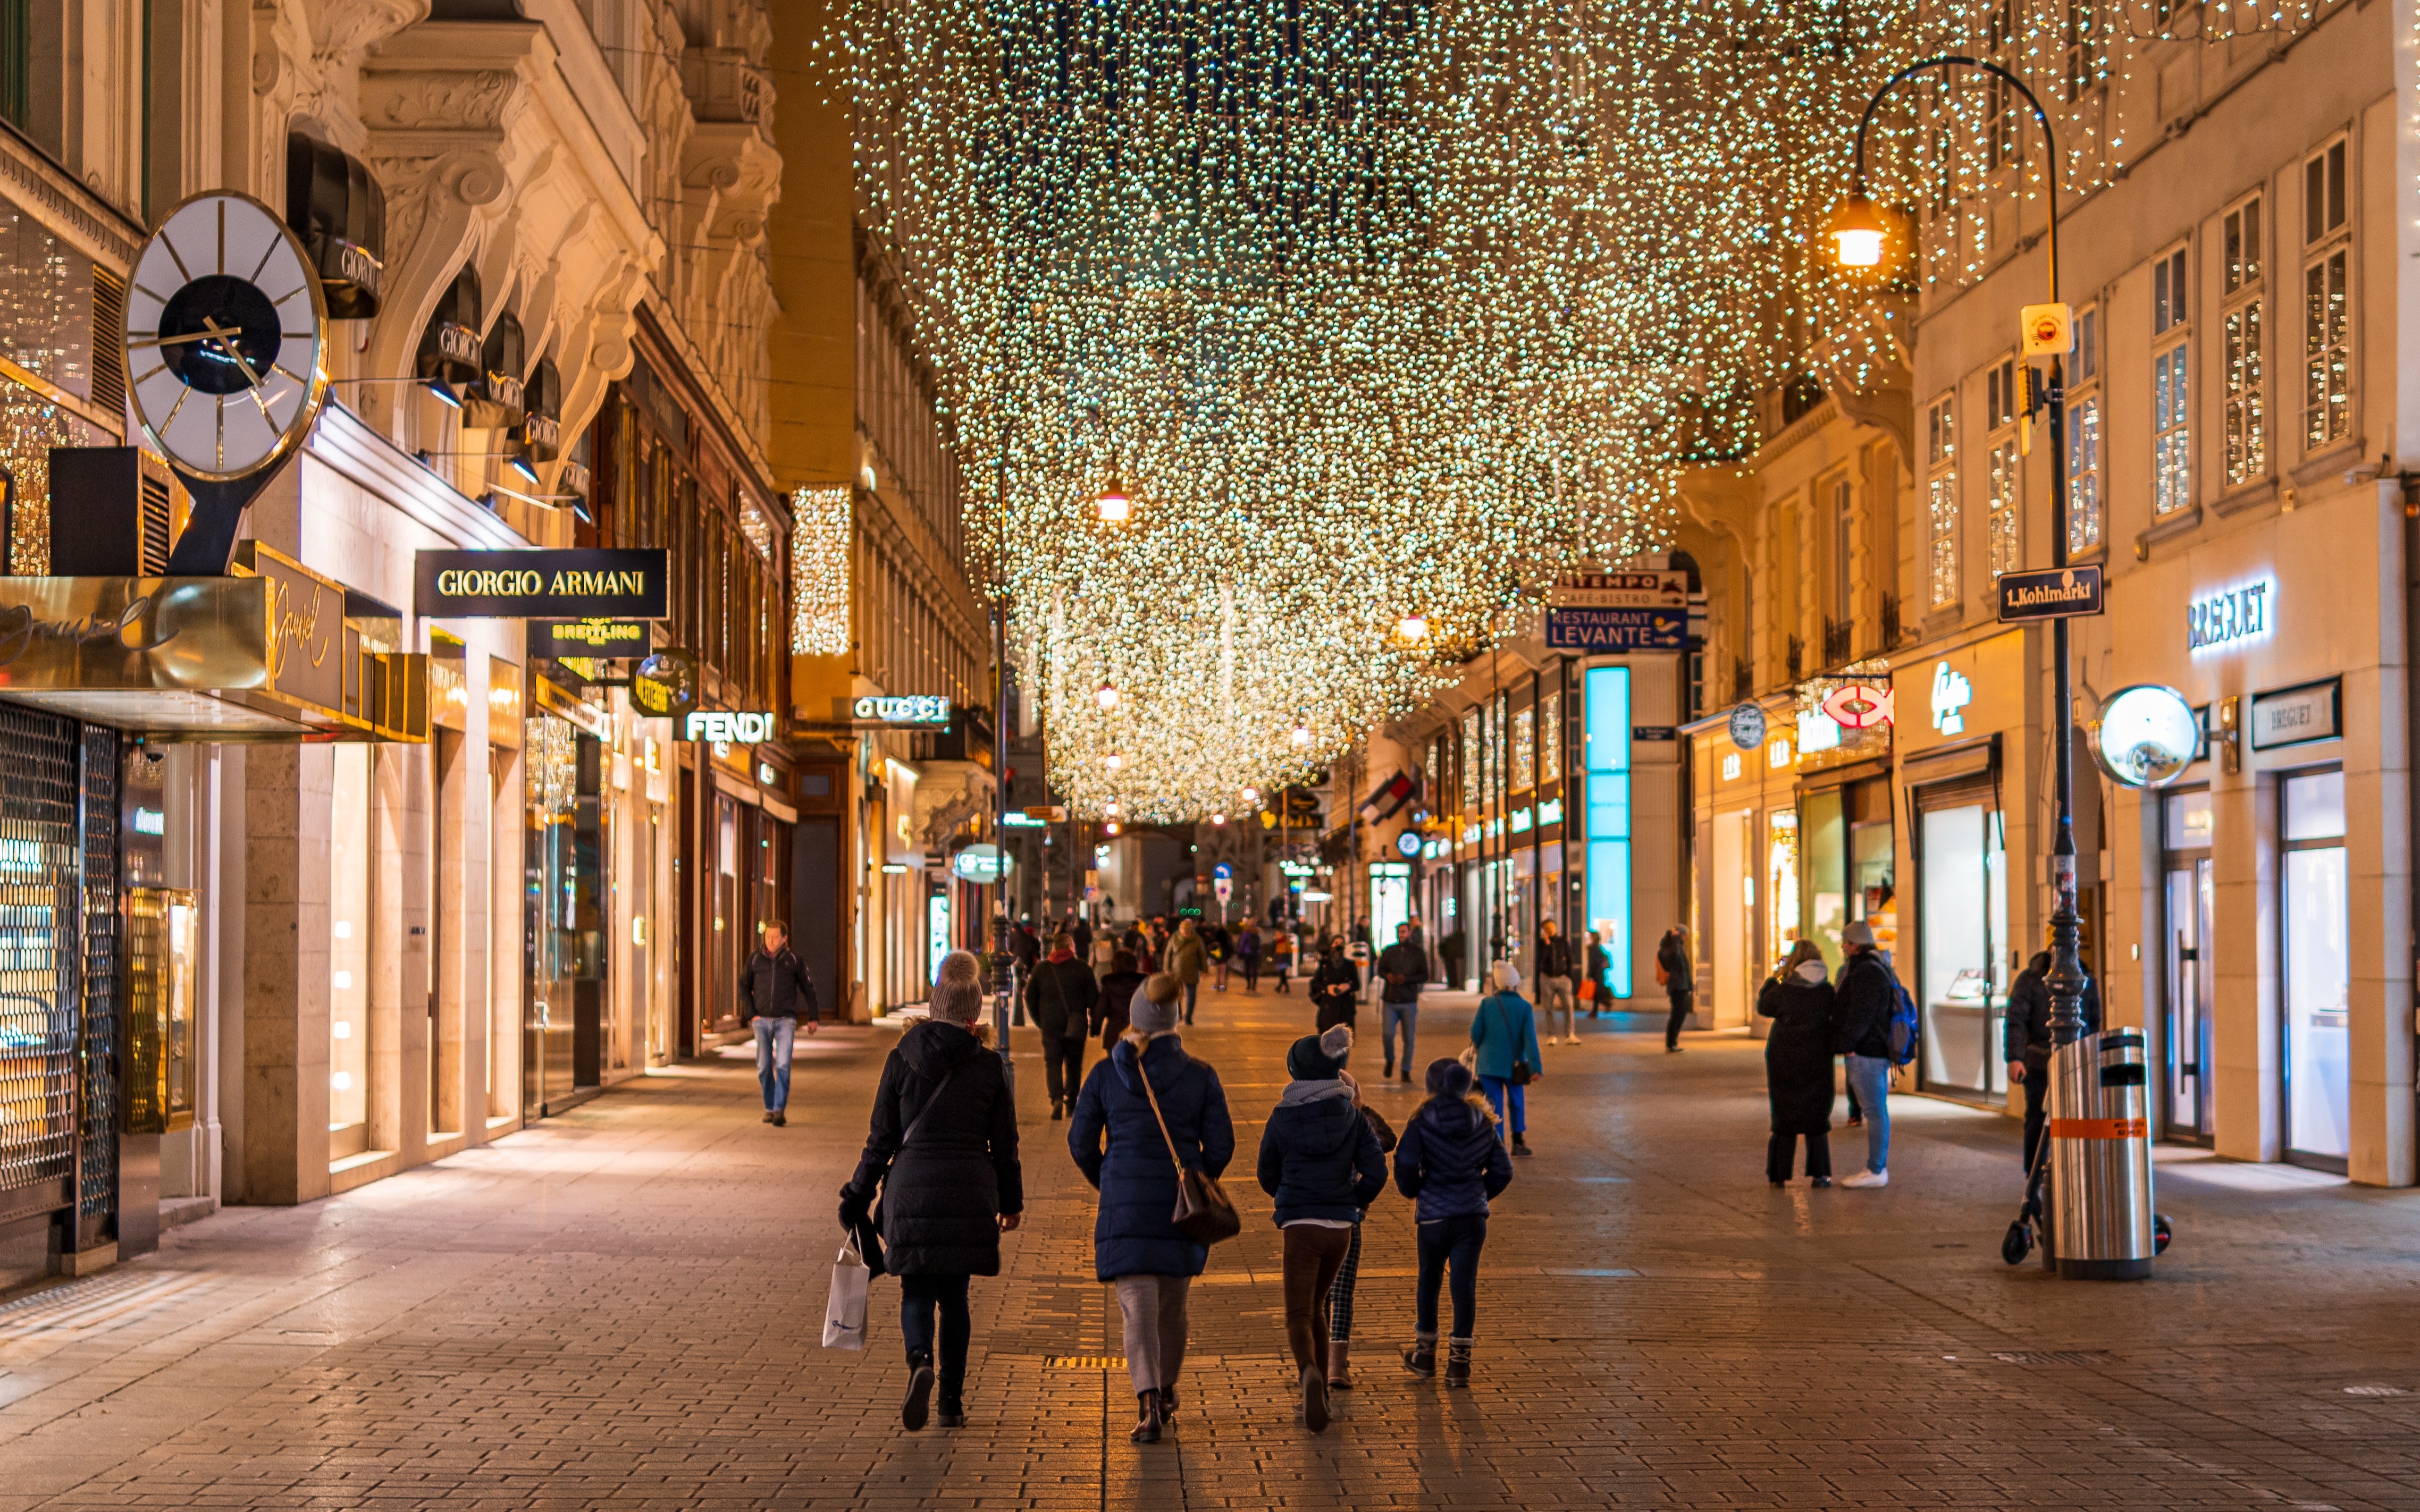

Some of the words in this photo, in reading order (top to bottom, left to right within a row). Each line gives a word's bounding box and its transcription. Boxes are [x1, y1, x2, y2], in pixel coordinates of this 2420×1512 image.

[438, 570, 541, 596] GIORGIO
[549, 570, 644, 596] ARMANI
[1577, 575, 1656, 587] TEMPO
[1552, 612, 1650, 624] RESTAURANT
[2187, 580, 2266, 652] BREGUET
[552, 624, 641, 639] BREITLING
[1552, 626, 1651, 645] LEVANTE
[854, 698, 946, 719] GUCCI
[2271, 704, 2310, 731] BREGUET
[687, 711, 775, 743] FENDI
